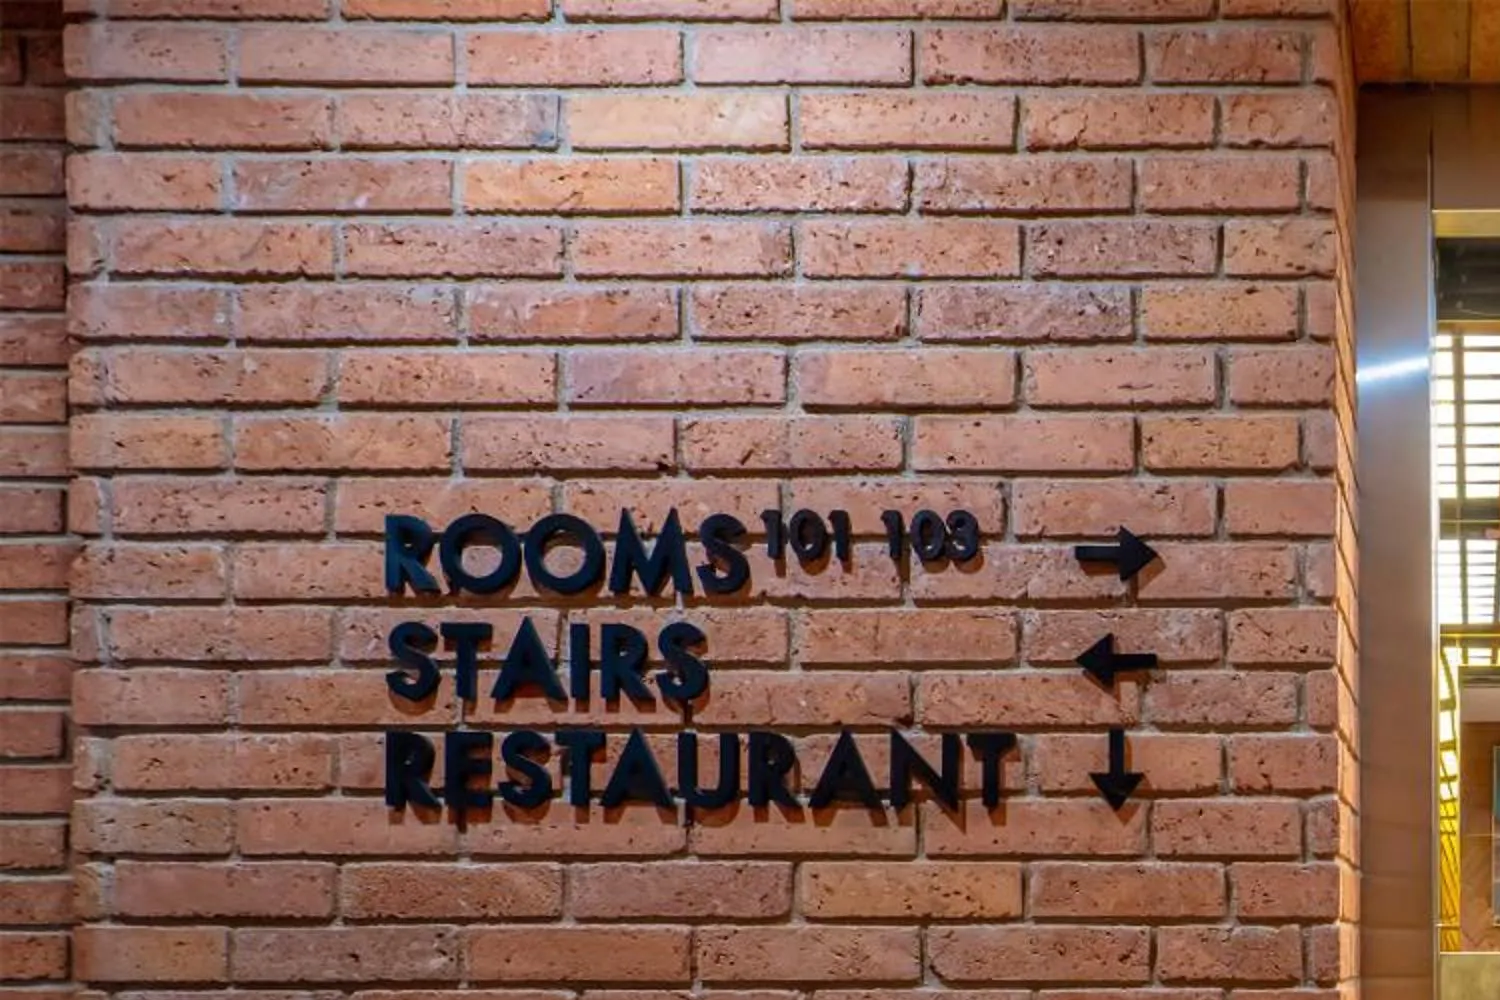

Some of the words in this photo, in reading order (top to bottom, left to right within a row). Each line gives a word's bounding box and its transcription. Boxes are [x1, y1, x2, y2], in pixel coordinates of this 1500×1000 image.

[384, 507, 750, 595] ROOMS
[760, 508, 851, 561] 101
[881, 509, 980, 562] 103
[385, 616, 710, 702] STAIRS
[384, 727, 1018, 813] RESTAURANT
